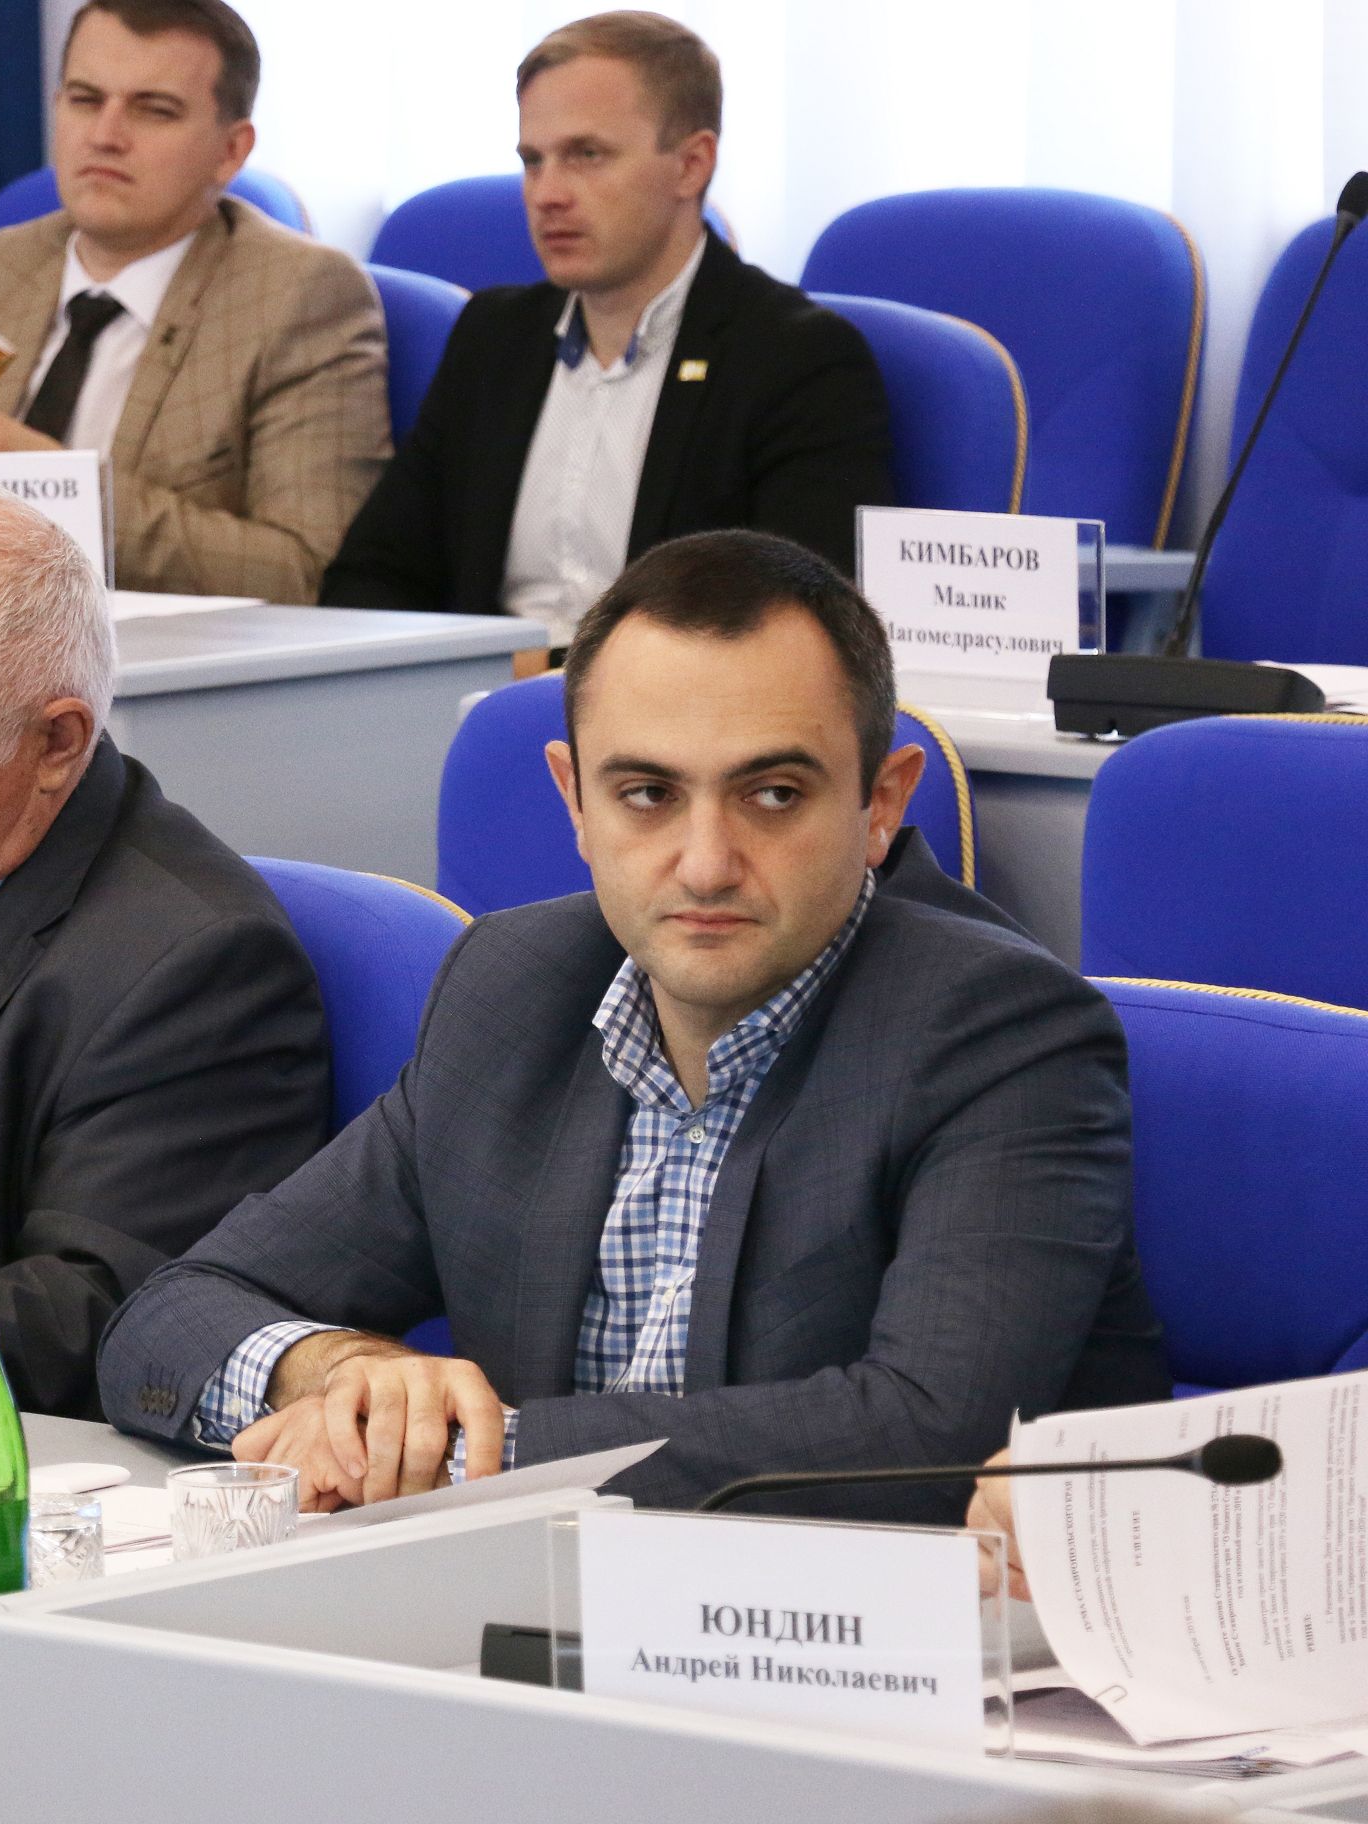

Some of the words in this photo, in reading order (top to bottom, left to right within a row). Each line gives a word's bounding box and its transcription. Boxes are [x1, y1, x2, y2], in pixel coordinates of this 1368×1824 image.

[900, 539, 1040, 571] КИМБАРОВ
[934, 584, 1007, 610] Малик
[700, 1603, 864, 1647] ЮНДИН
[631, 1647, 741, 1682] Андрей
[750, 1655, 939, 1697] Николаевич
